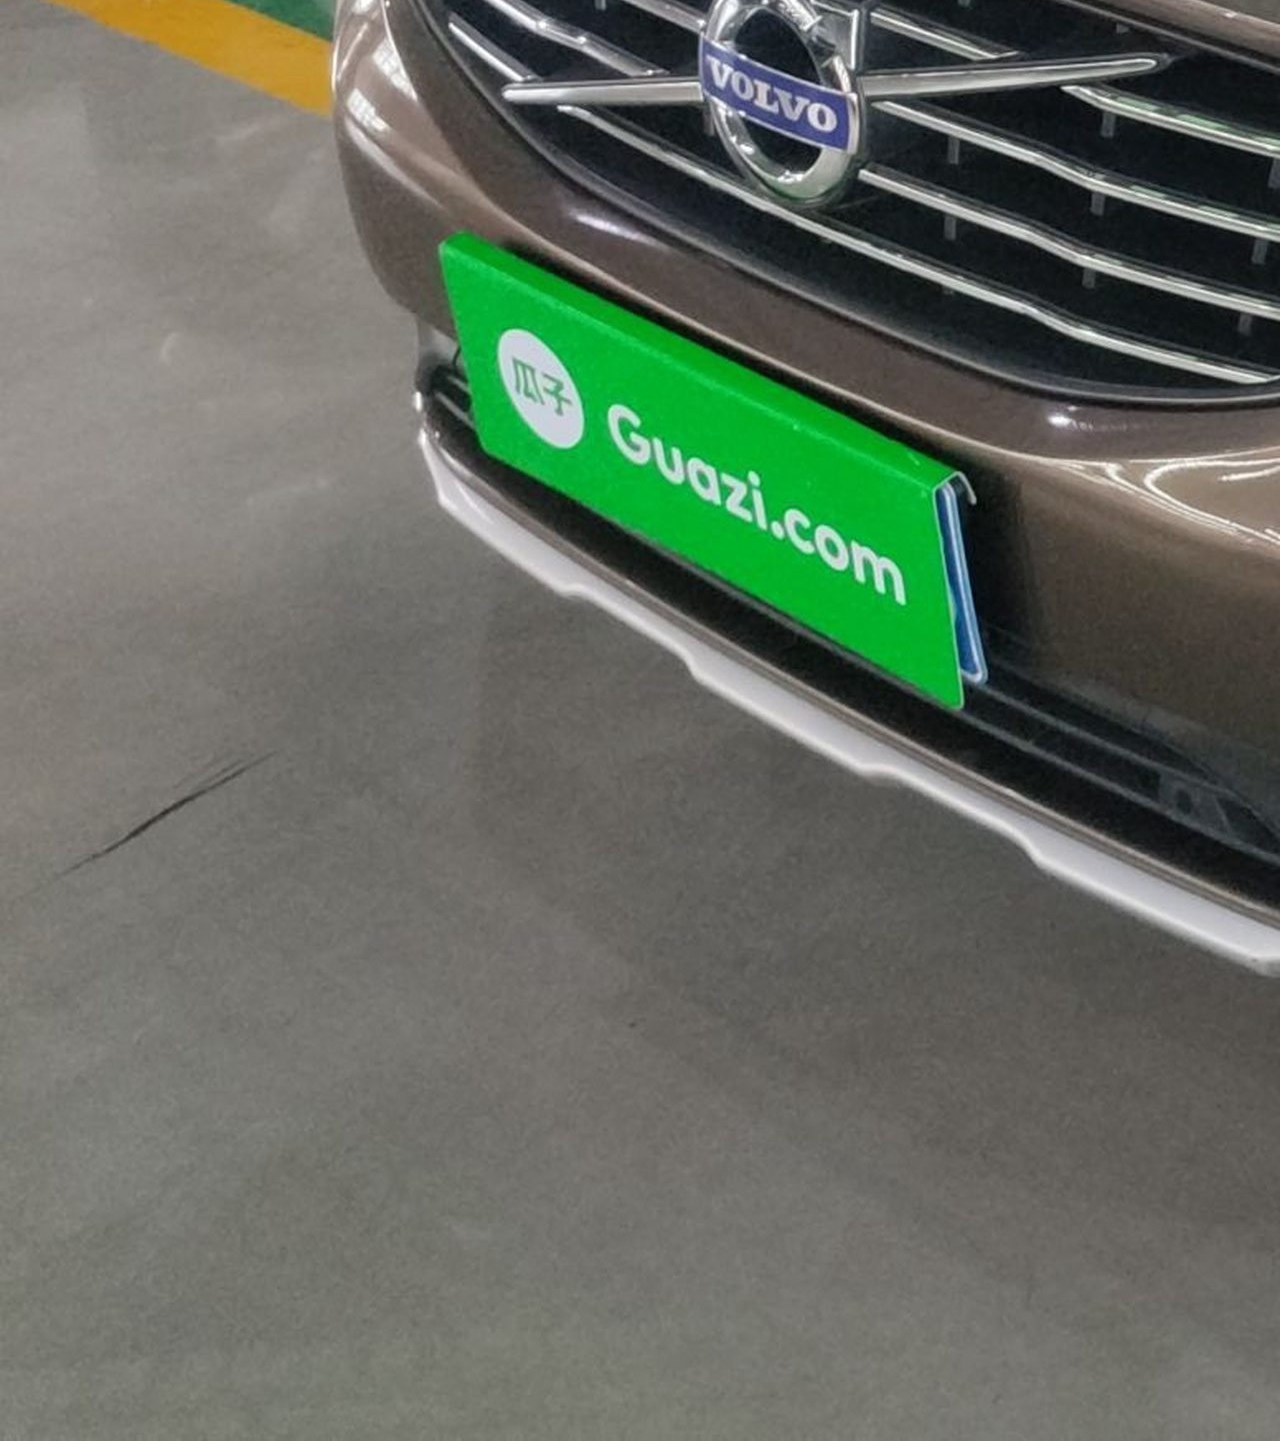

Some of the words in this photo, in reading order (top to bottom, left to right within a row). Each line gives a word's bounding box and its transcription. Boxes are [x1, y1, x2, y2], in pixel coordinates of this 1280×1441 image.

[706, 55, 838, 133] VOLVO
[511, 356, 573, 417] 瓜子
[607, 404, 906, 605] Guazi.com
